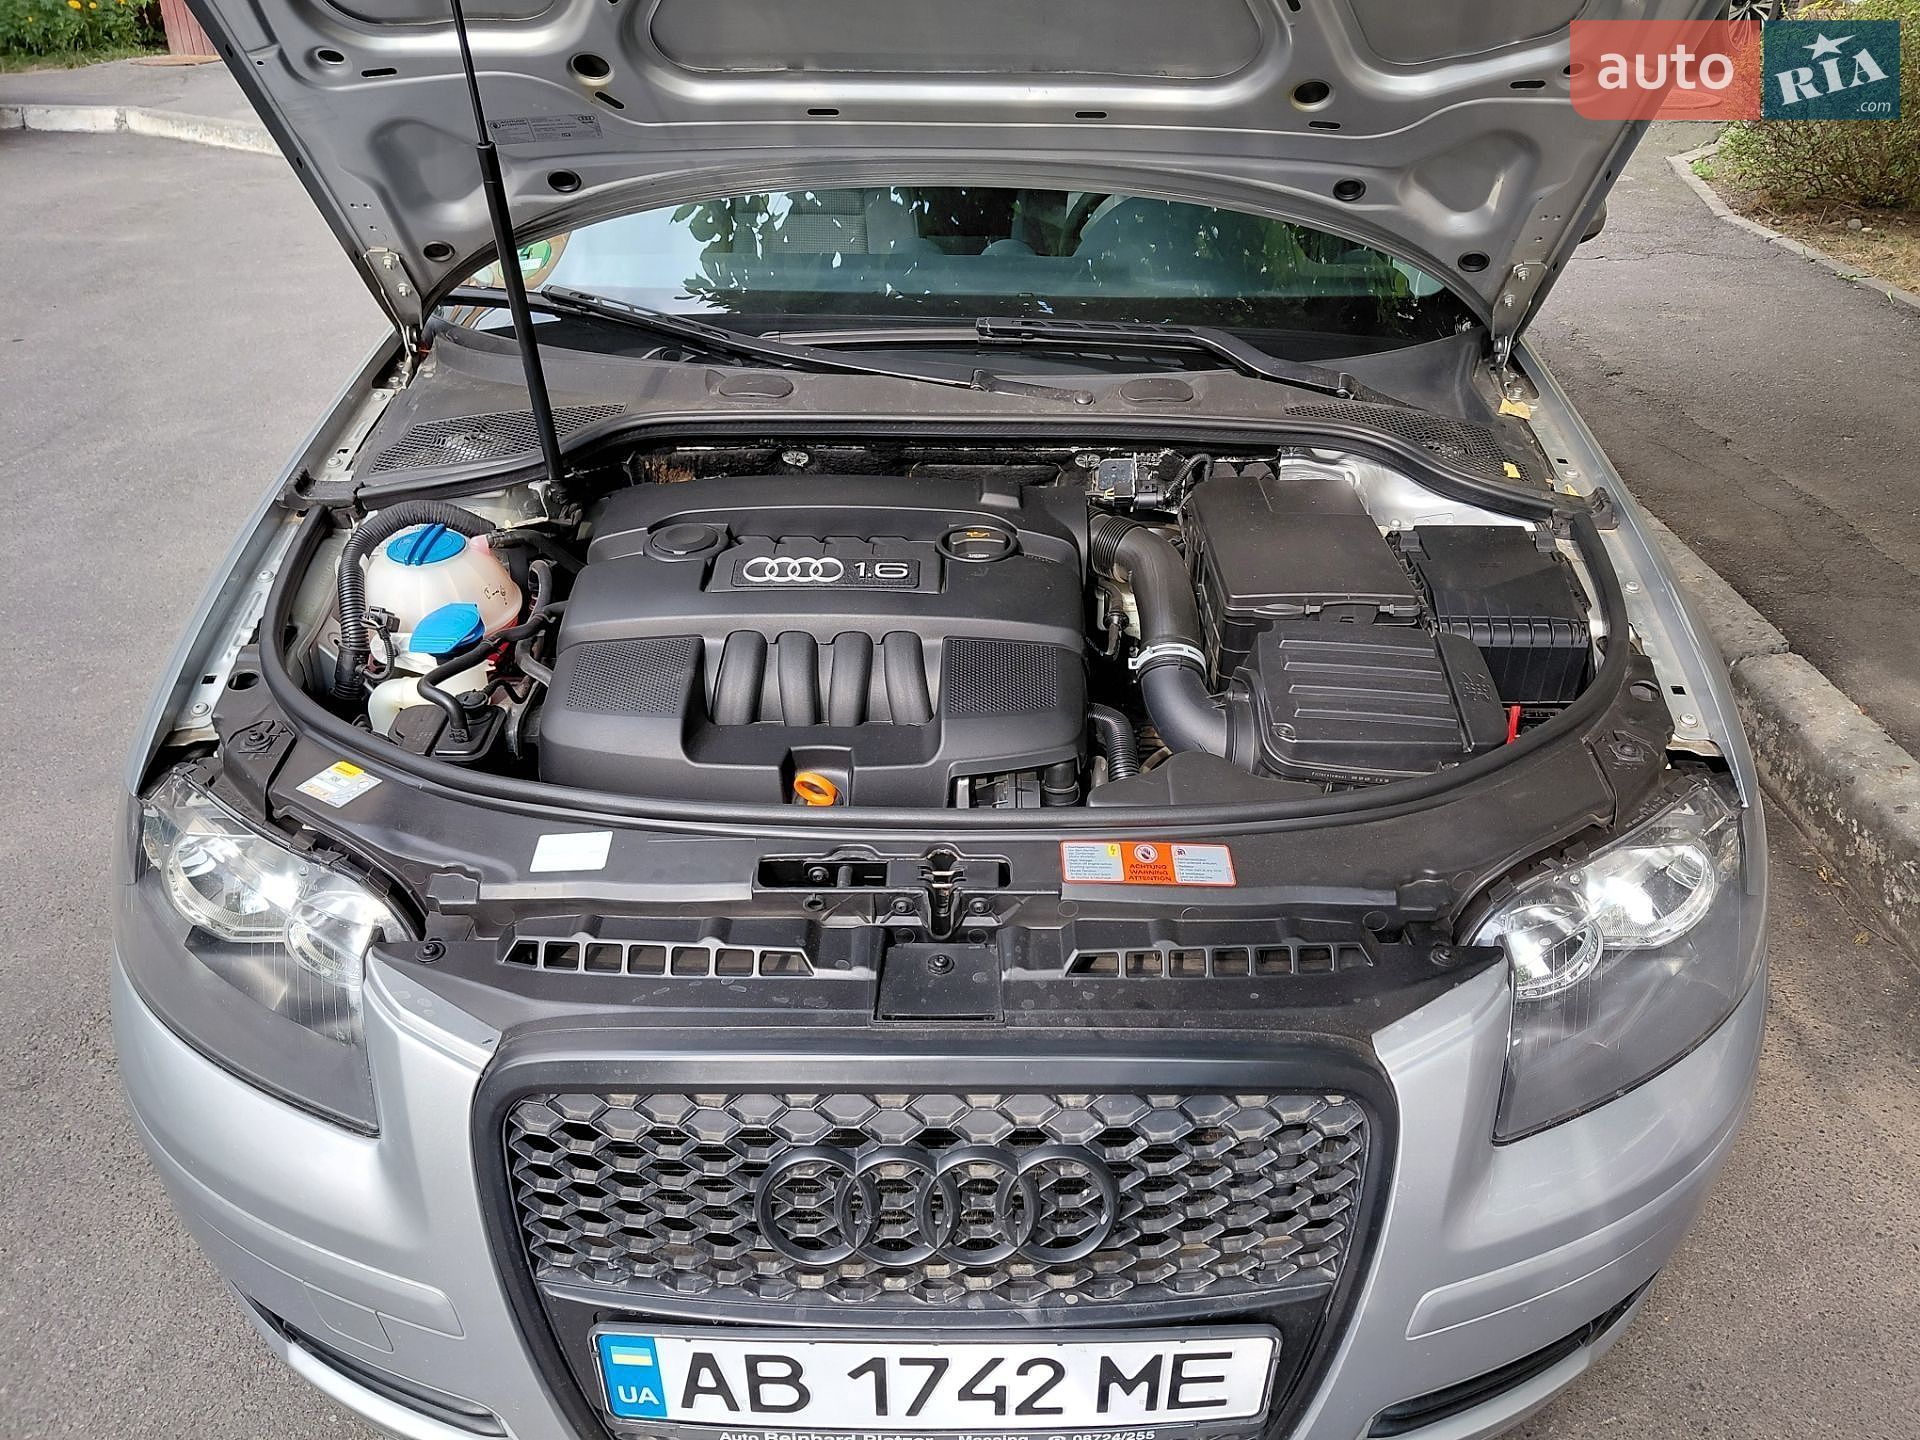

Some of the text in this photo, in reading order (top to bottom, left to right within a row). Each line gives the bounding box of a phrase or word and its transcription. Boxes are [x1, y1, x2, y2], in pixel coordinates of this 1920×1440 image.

[854, 562, 908, 578] 1.6
[681, 1352, 1233, 1416] AB 1742 ME
[617, 1385, 660, 1404] UA
